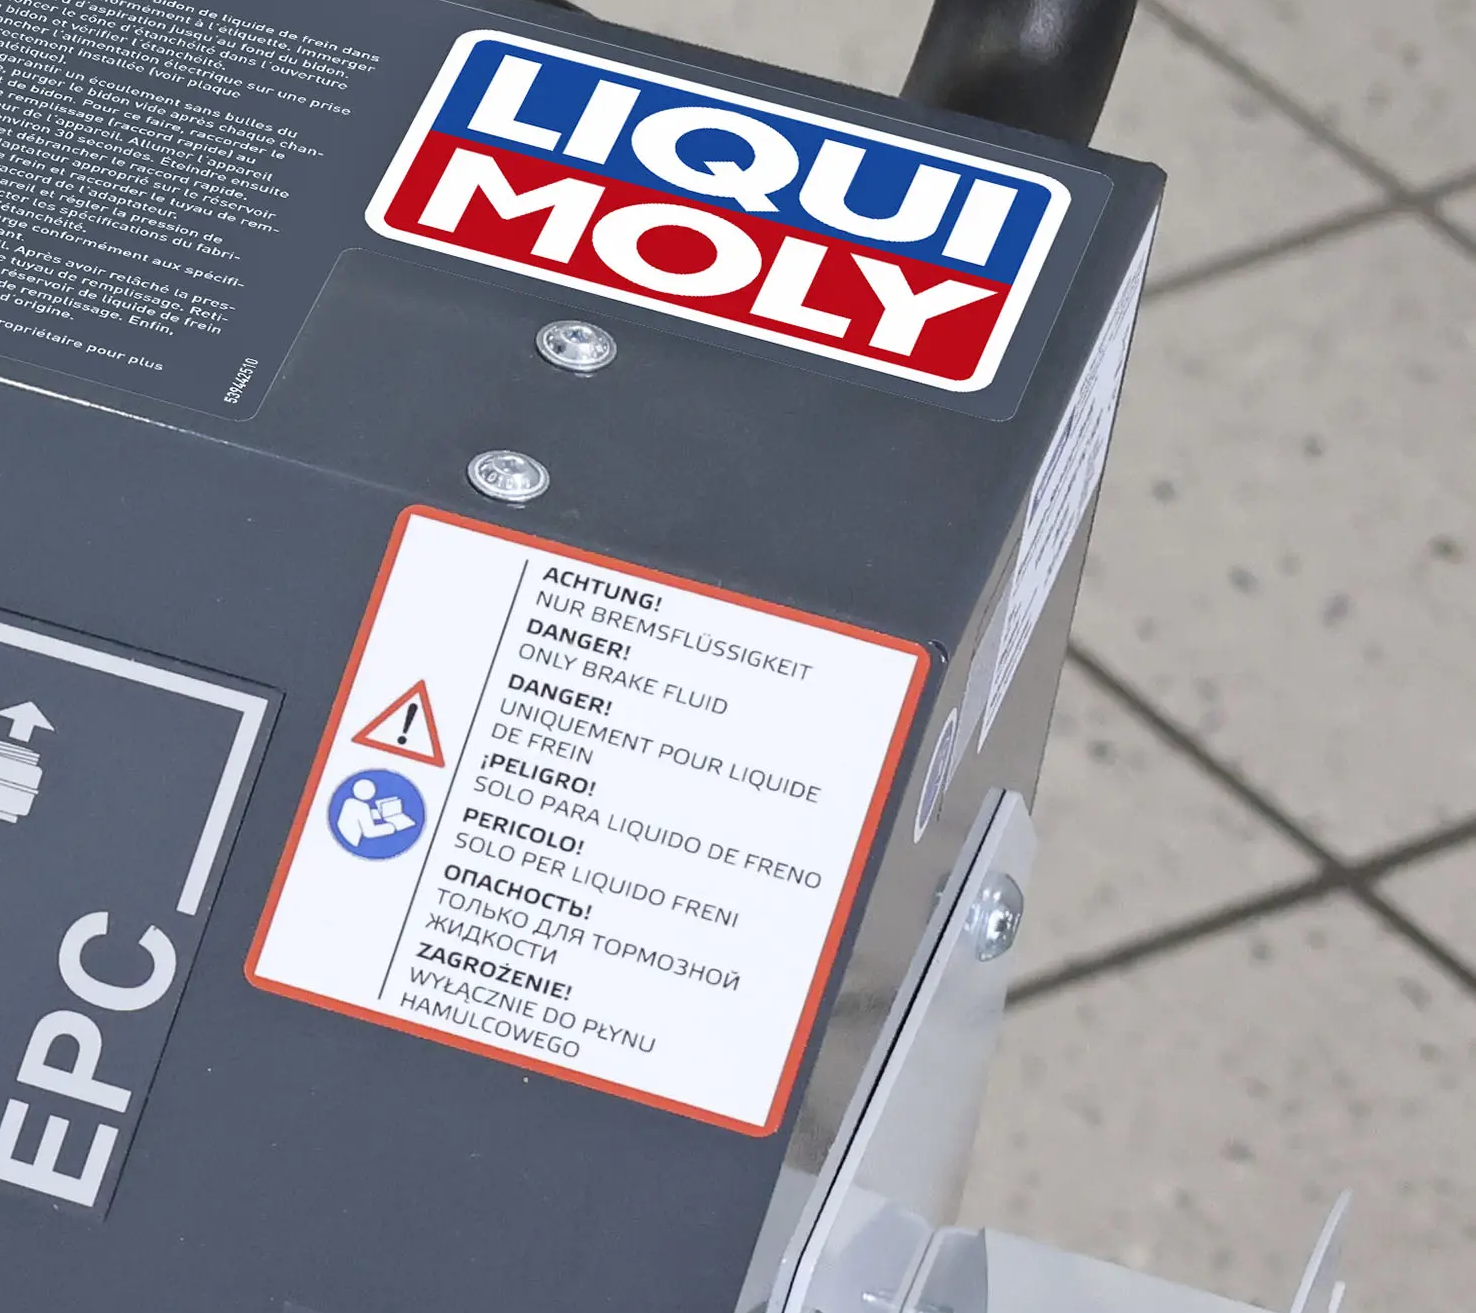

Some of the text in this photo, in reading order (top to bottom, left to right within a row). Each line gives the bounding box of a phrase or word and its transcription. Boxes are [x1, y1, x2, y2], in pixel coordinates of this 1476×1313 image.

[198, 9, 218, 20] de
[221, 13, 275, 35] liquide
[278, 30, 299, 41] de
[301, 35, 338, 52] frein
[341, 46, 381, 63] dans
[148, 66, 186, 83] (voir
[186, 78, 242, 99] plaque
[6, 79, 27, 91] de
[29, 84, 76, 105] bidon.
[81, 98, 121, 115] Pour
[123, 111, 142, 121] ce
[145, 115, 185, 135] faire,
[189, 129, 268, 154] raccorder
[270, 149, 286, 160] le
[466, 54, 1019, 266] LIQUI
[417, 147, 998, 357] MOLY
[85, 344, 126, 360] pour
[127, 356, 164, 371] plus
[224, 357, 259, 404] 539442510
[542, 566, 663, 613] ACHTUNG!
[526, 618, 632, 661] DANGER!
[535, 590, 813, 680] NUR BREMSFLÜSSIGKEIT
[507, 673, 613, 717] DANGER!
[518, 643, 728, 715] ONLY BRAKE FLUID
[491, 722, 594, 765] DE FREIN
[500, 697, 822, 804] UNIQUEMENT POUR LIQUIDE
[480, 752, 597, 797] ¡PELIGRO!
[462, 807, 585, 856] PERICOLO!
[473, 775, 822, 889] SOLO PARA LIQUIDO DE FRENO
[443, 864, 593, 920] ОПАСНОСТЬ!
[454, 832, 739, 928] SOLO PER LIQUIDO FRENI
[425, 913, 558, 965] ЖИДКОСТИ
[437, 887, 741, 991] ТОЛЬКО ДЛЯ ТОРМОЗНОЙ
[415, 941, 573, 1001] ZAGROŻENIE!
[400, 992, 580, 1058] HAMULCOWEGO
[410, 966, 656, 1053] WYŁĄCZNIE DO PŁYNU
